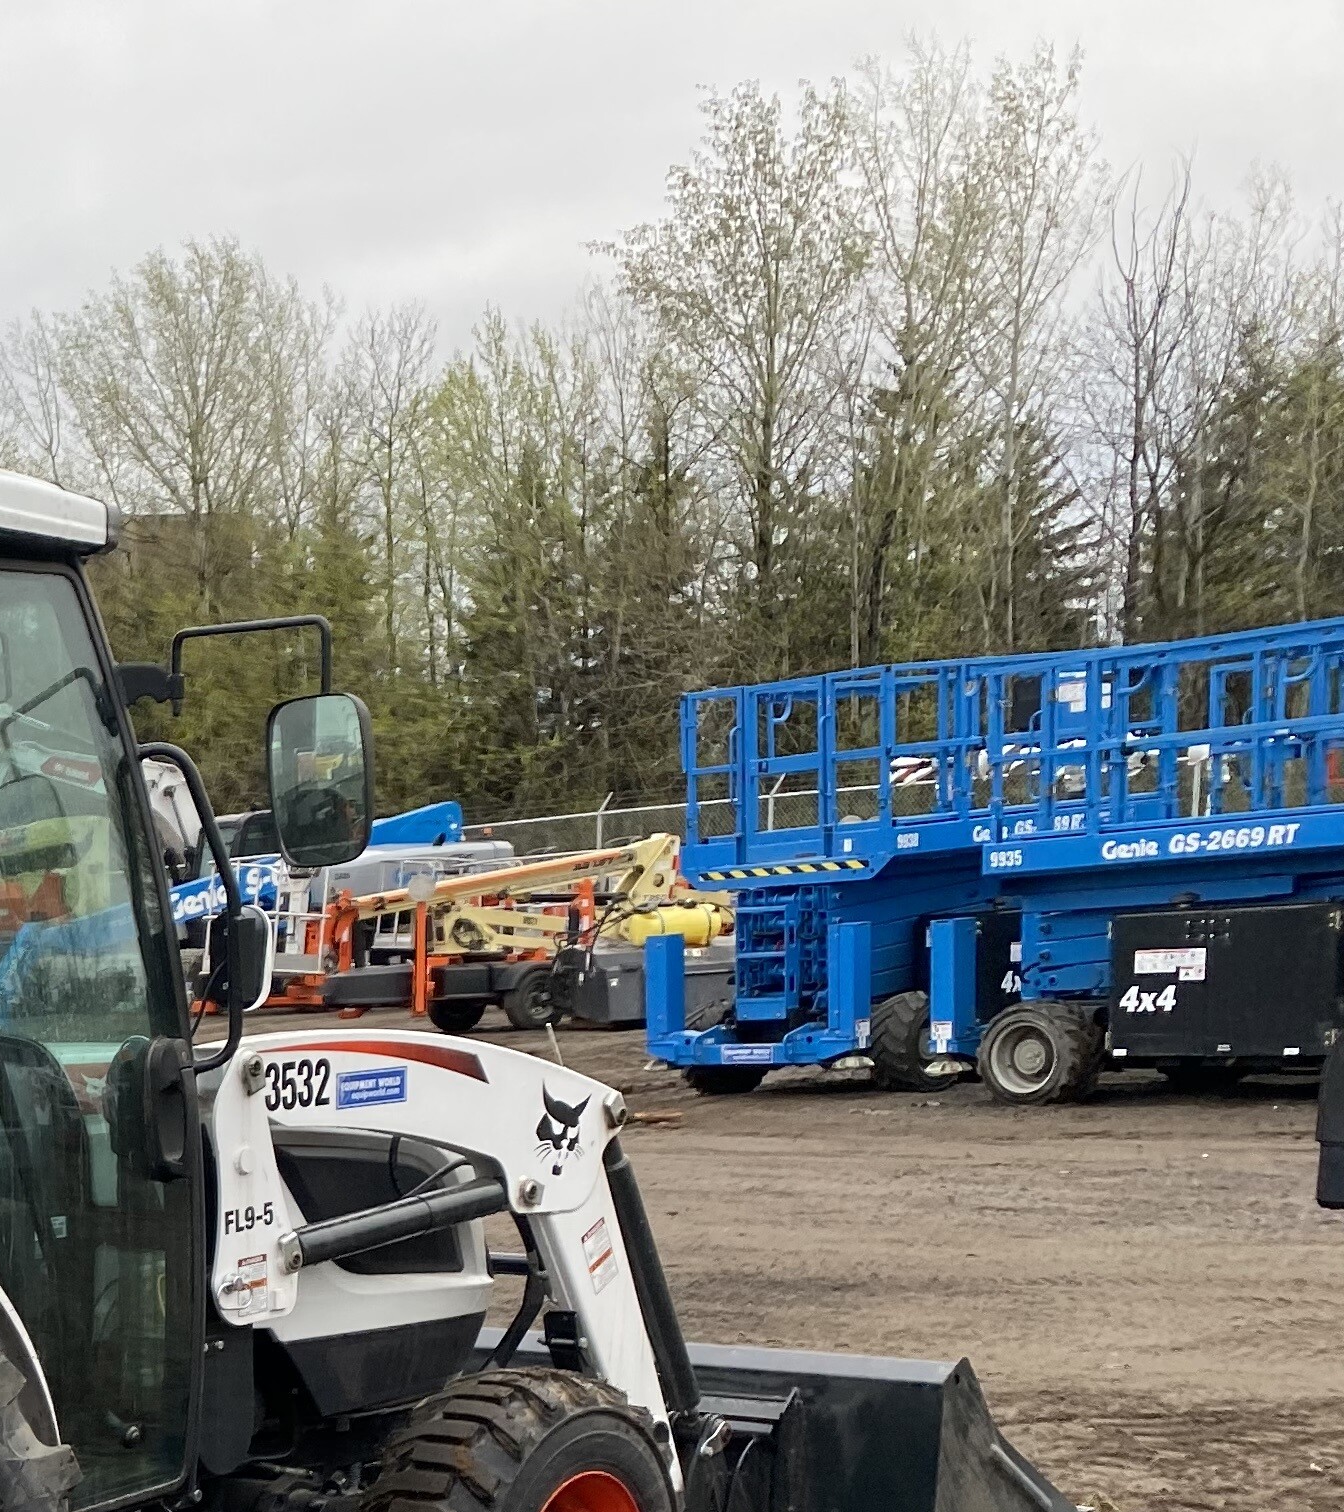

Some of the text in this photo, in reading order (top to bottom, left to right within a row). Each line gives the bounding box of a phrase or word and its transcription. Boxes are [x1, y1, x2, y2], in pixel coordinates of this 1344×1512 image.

[989, 850, 1023, 868] 9935
[1101, 838, 1159, 860] Genie
[1119, 984, 1178, 1014] 4x4
[264, 1057, 331, 1112] 3532
[378, 1075, 402, 1088] WORLD
[224, 1201, 274, 1236] FL9-5
